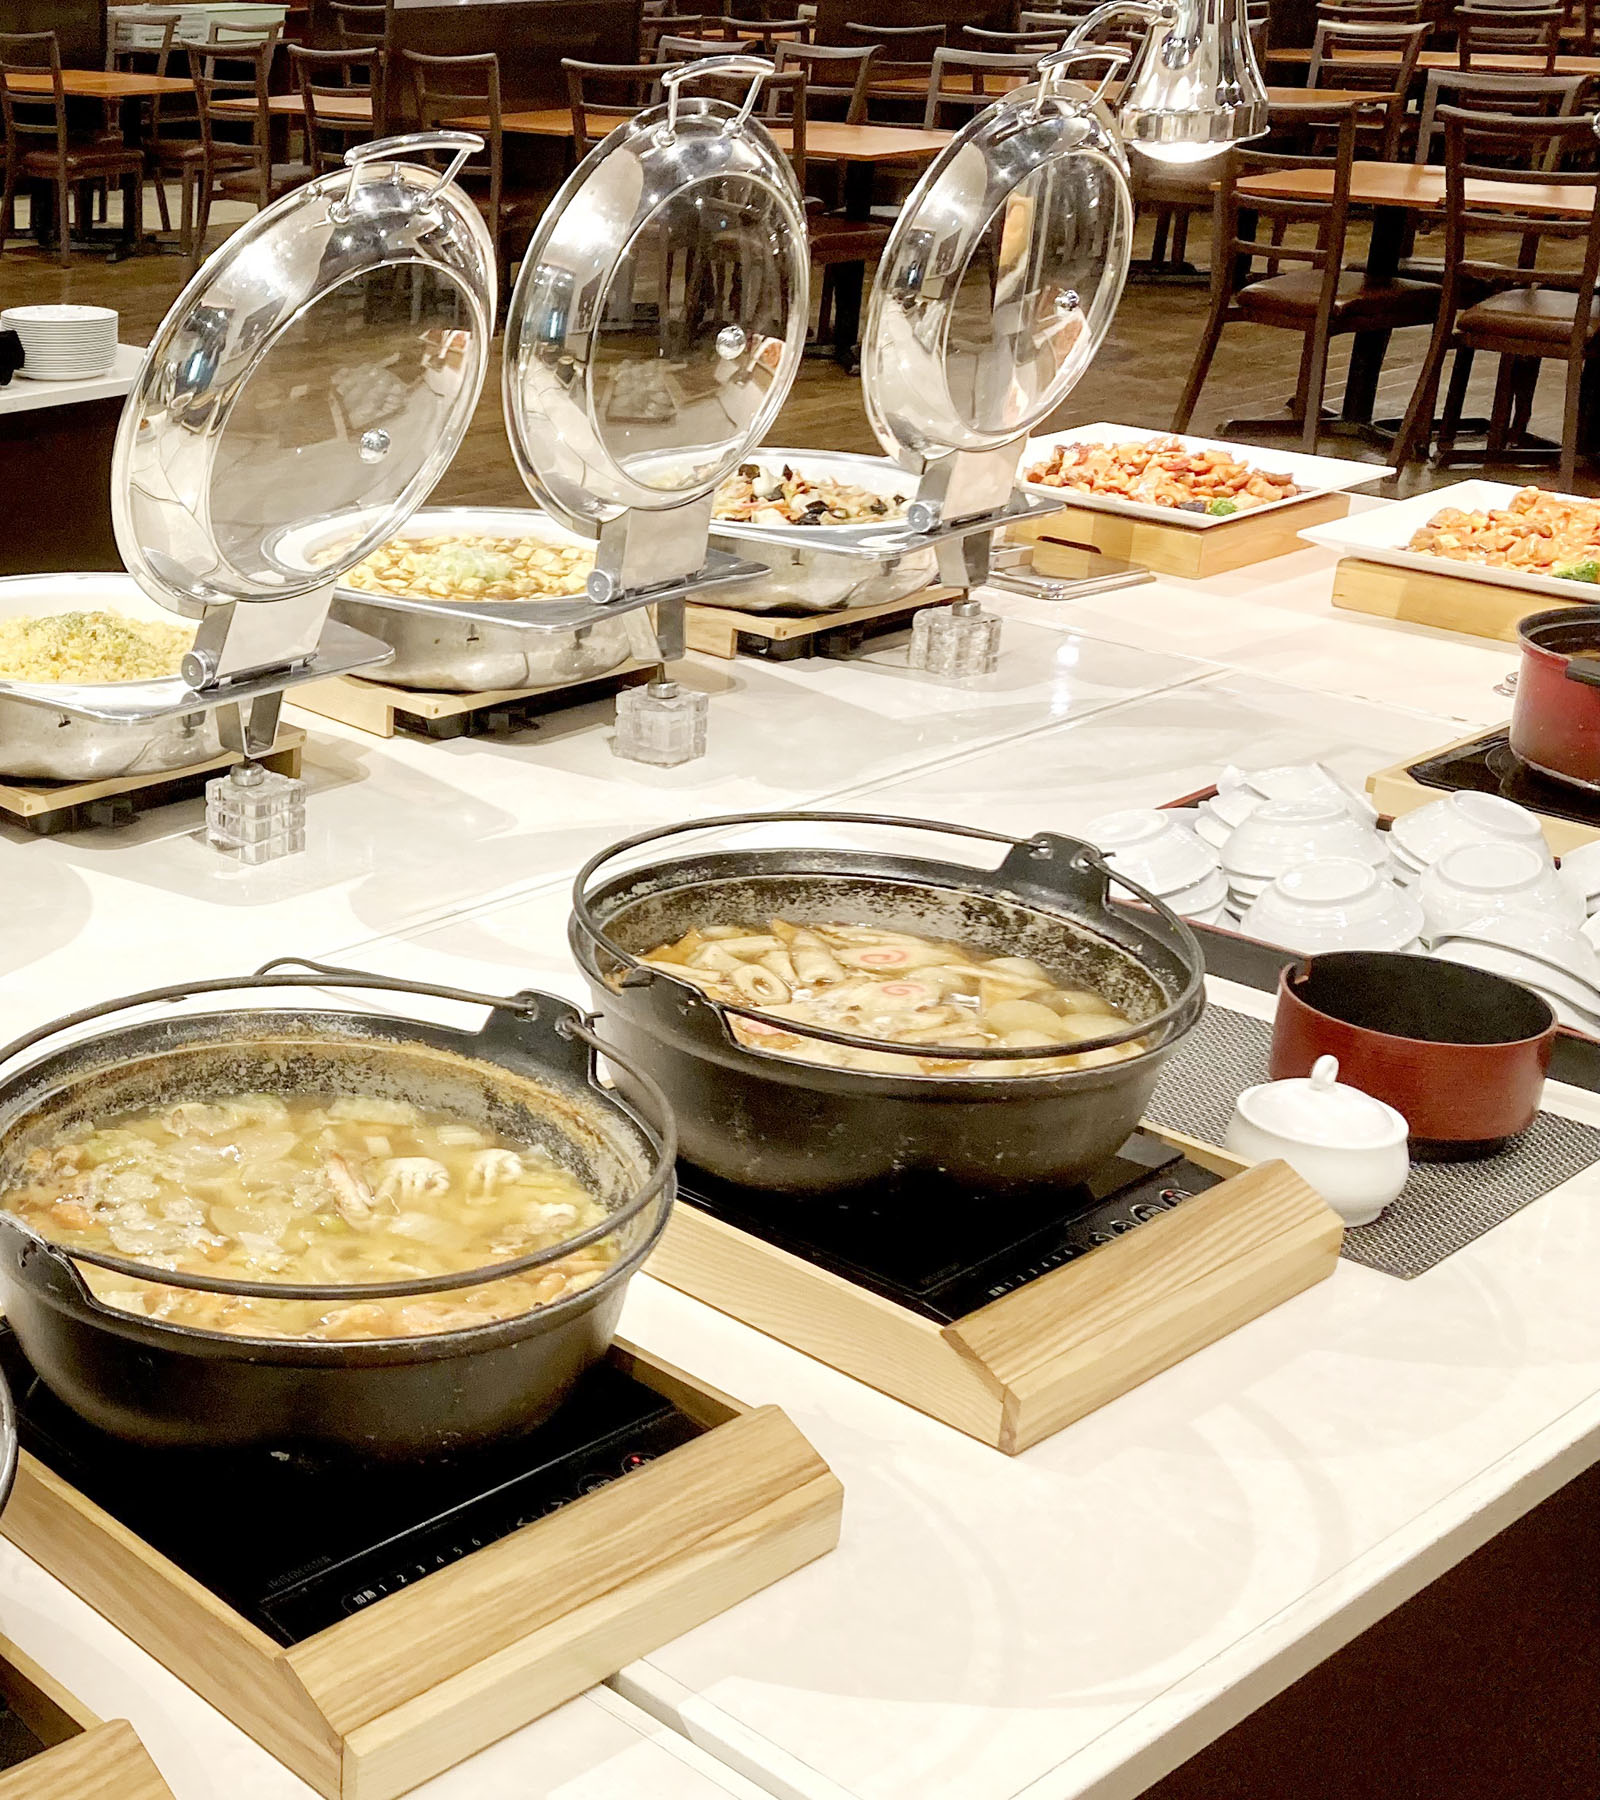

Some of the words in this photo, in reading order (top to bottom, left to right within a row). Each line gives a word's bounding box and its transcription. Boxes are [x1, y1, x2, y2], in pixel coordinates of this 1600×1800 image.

[396, 1573, 408, 1584] 2
[416, 1563, 427, 1574] 3
[435, 1555, 445, 1565] 4
[453, 1546, 464, 1556] 5
[471, 1537, 482, 1547] 6
